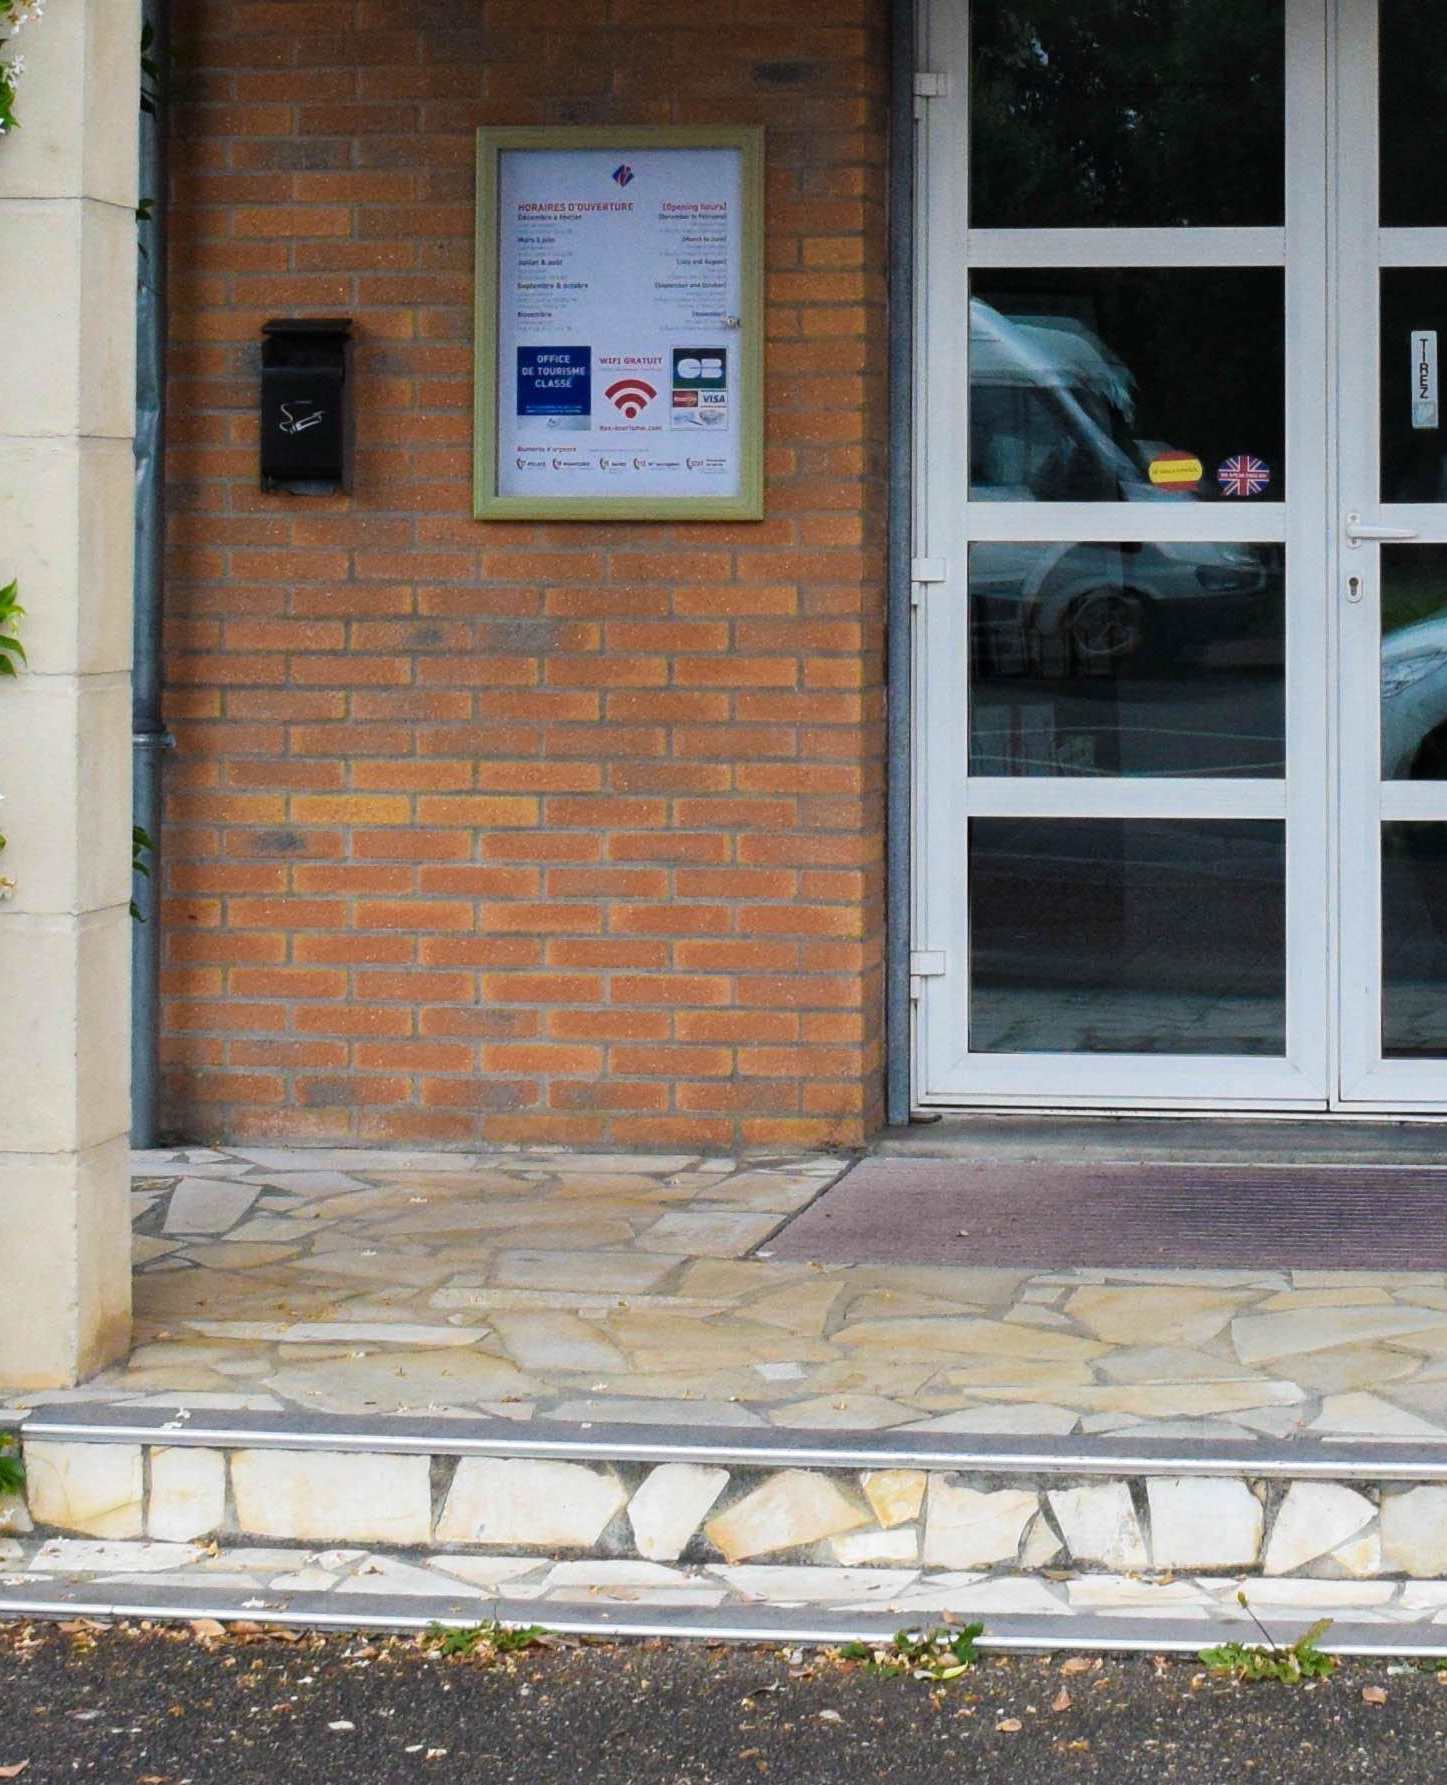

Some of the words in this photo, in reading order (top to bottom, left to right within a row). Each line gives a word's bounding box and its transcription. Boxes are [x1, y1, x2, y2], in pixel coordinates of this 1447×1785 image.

[517, 202, 566, 212] HORAIRES
[568, 202, 634, 212] D'OUVERTURE
[536, 354, 571, 364] OFFICE
[599, 356, 622, 365] WIFI
[623, 356, 663, 365] GRATUIT
[521, 366, 535, 376] DE
[538, 366, 586, 376] TOURISME
[1419, 338, 1429, 399] TIREZ
[703, 394, 726, 403] VISA
